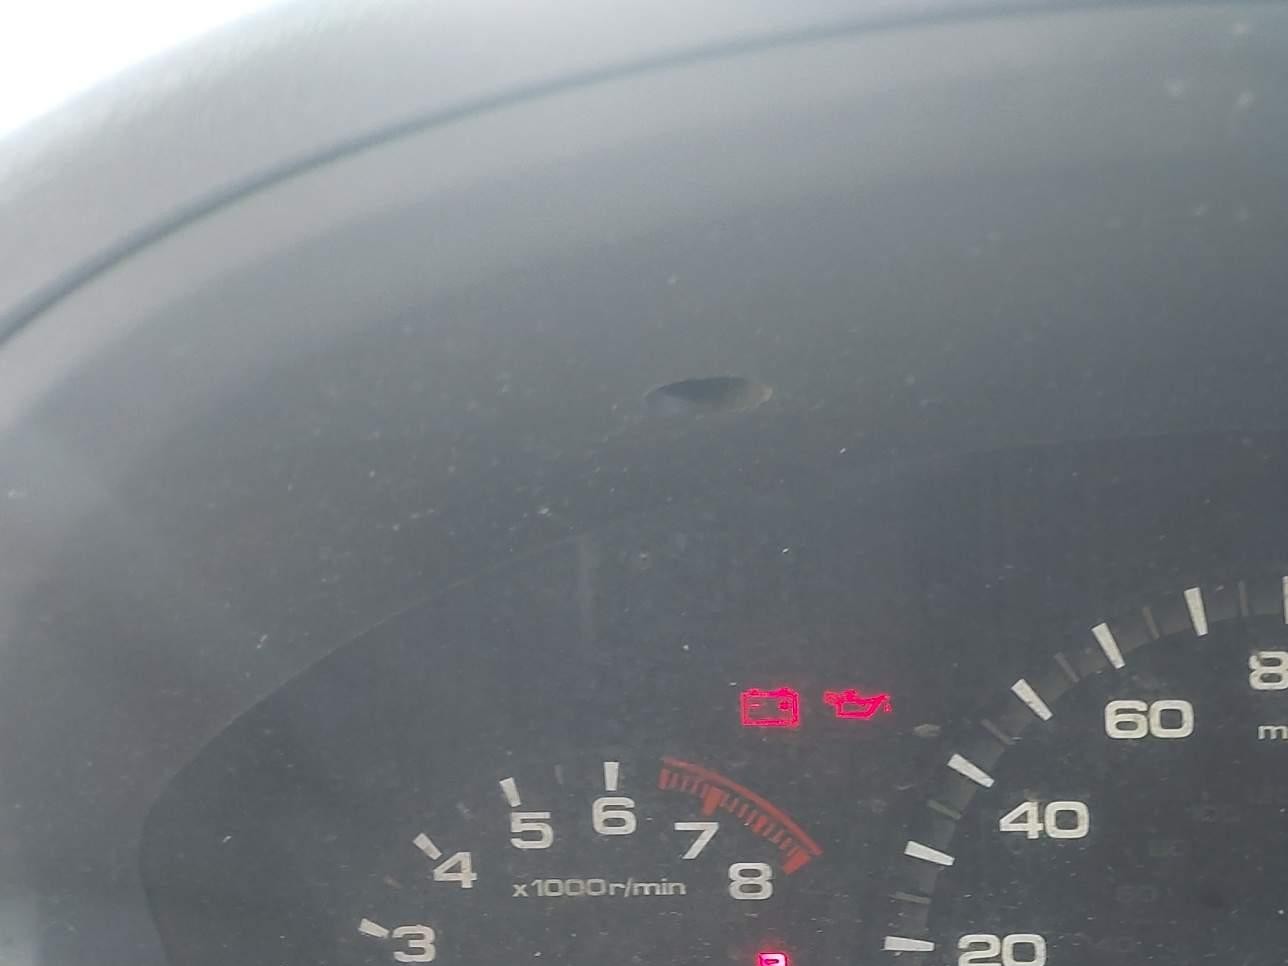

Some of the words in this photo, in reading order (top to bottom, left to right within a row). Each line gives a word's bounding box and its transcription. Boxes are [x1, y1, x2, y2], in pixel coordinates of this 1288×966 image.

[1104, 699, 1194, 740] 60
[510, 811, 554, 849] 5
[592, 796, 637, 835] 6
[999, 801, 1090, 839] 40
[674, 822, 719, 860] 7
[433, 851, 477, 889] 4
[728, 862, 773, 900] 8
[393, 924, 436, 963] 3
